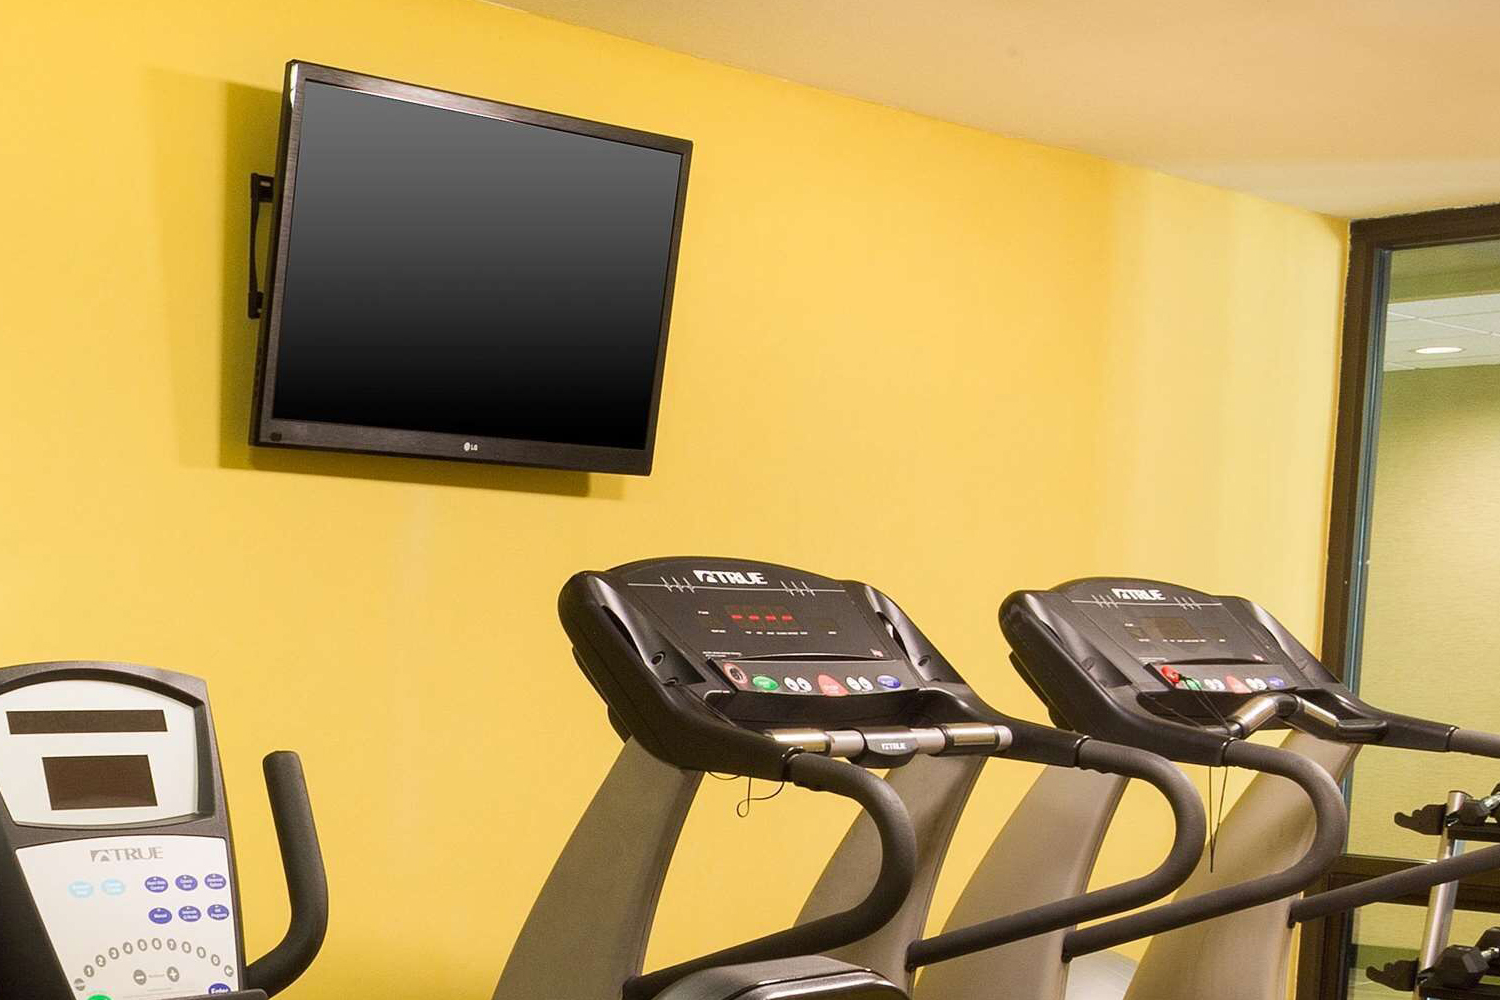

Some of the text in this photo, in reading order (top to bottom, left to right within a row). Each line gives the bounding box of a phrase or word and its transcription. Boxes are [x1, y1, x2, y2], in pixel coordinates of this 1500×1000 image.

[716, 571, 769, 585] TRUE
[1126, 588, 1167, 600] TRUE
[113, 846, 164, 861] TRUE
